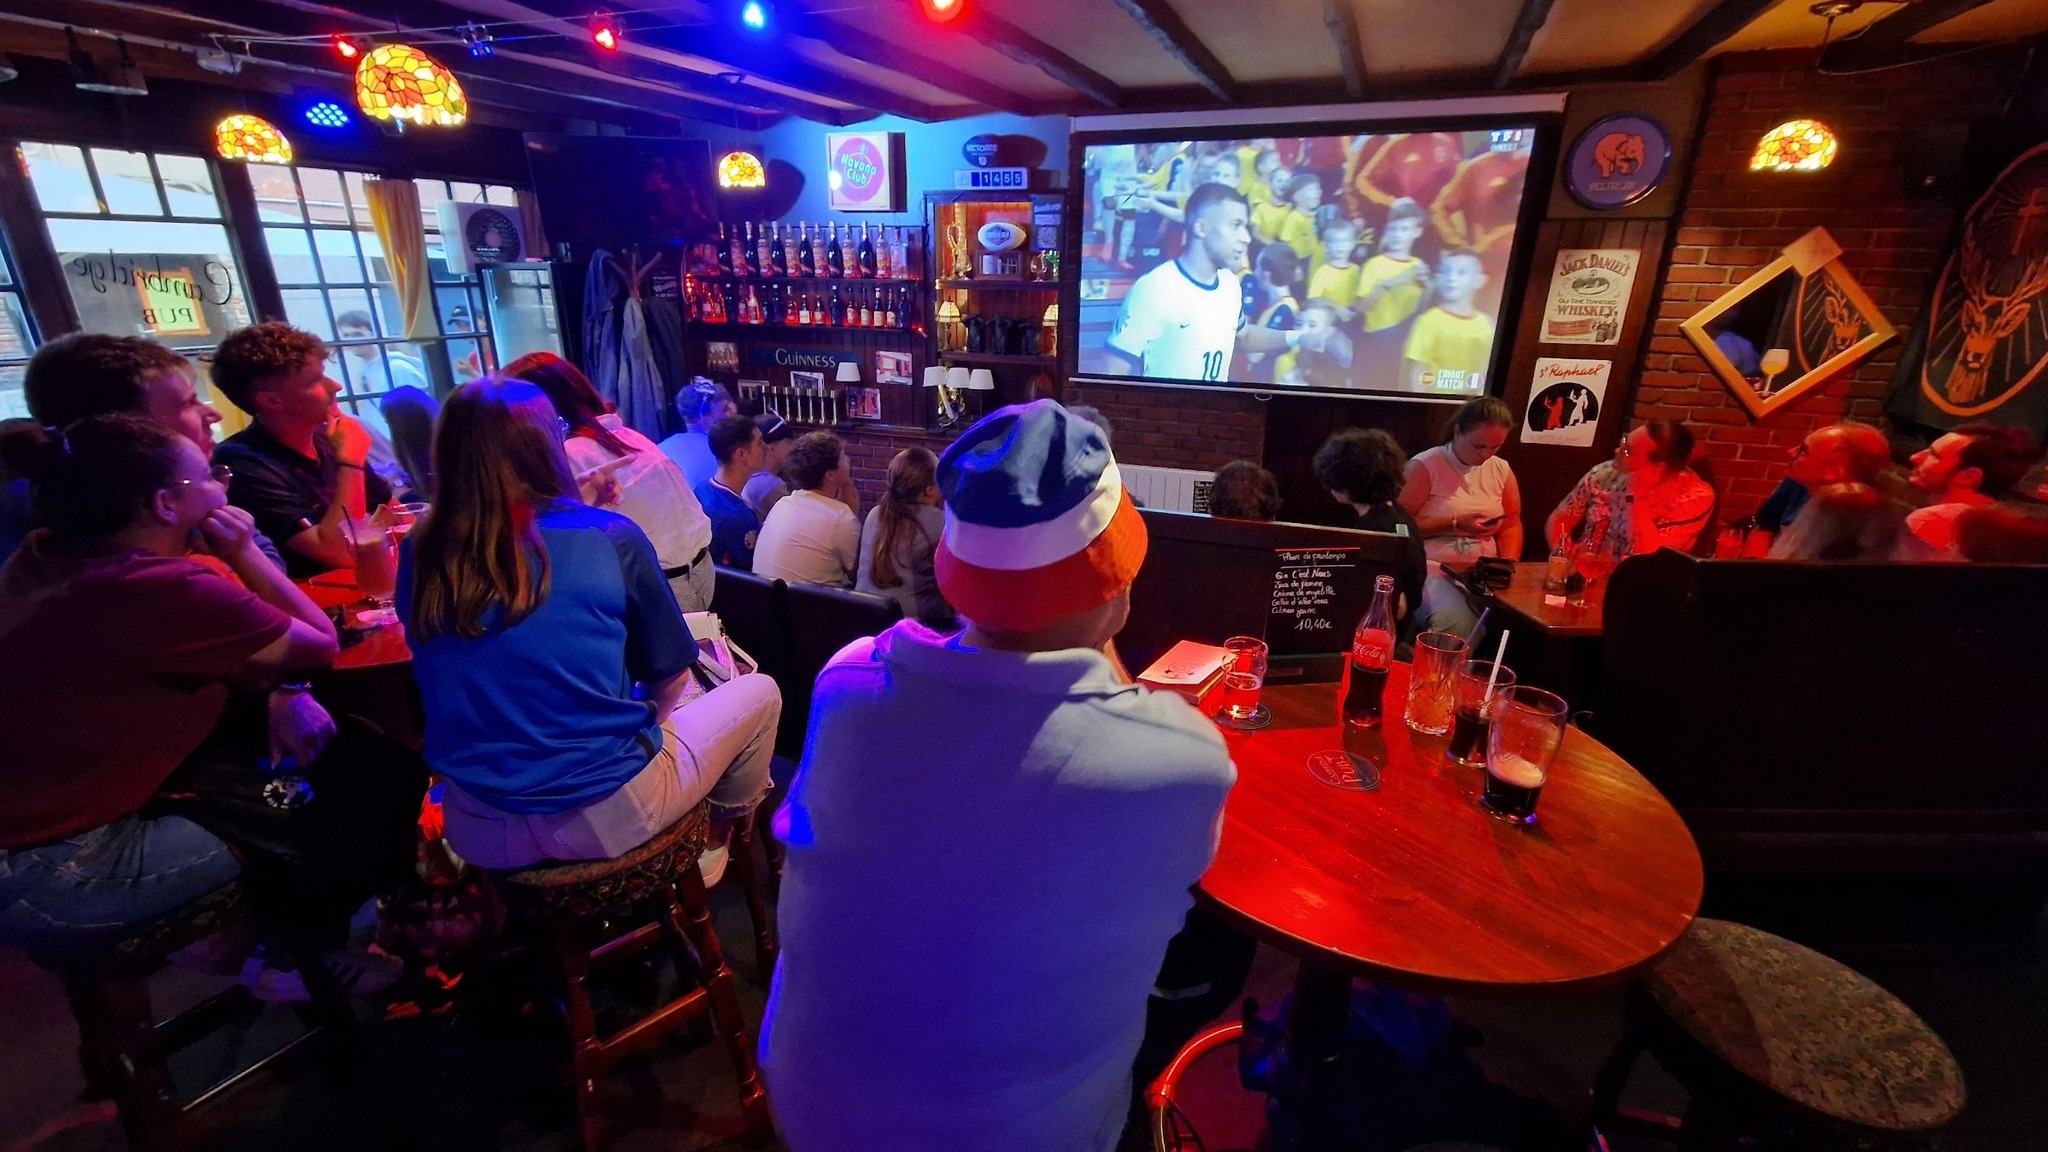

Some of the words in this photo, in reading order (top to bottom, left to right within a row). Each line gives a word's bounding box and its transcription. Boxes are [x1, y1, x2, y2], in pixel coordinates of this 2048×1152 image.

[1491, 130, 1522, 142] TF1
[841, 153, 877, 176] Havana
[847, 168, 868, 185] Club
[983, 173, 1021, 184] 1455
[1560, 257, 1587, 276] JACK
[1589, 253, 1631, 276] DANIEL'S
[1557, 305, 1617, 316] WHISKEY
[775, 348, 836, 368] GUINNESS
[1202, 350, 1223, 380] 10
[1436, 379, 1464, 390] MATCH
[1274, 580, 1289, 589] Jus
[1301, 581, 1323, 589] pomme
[1296, 588, 1304, 596] de
[1296, 607, 1317, 618] jaune
[1294, 618, 1333, 631] 10,40€
